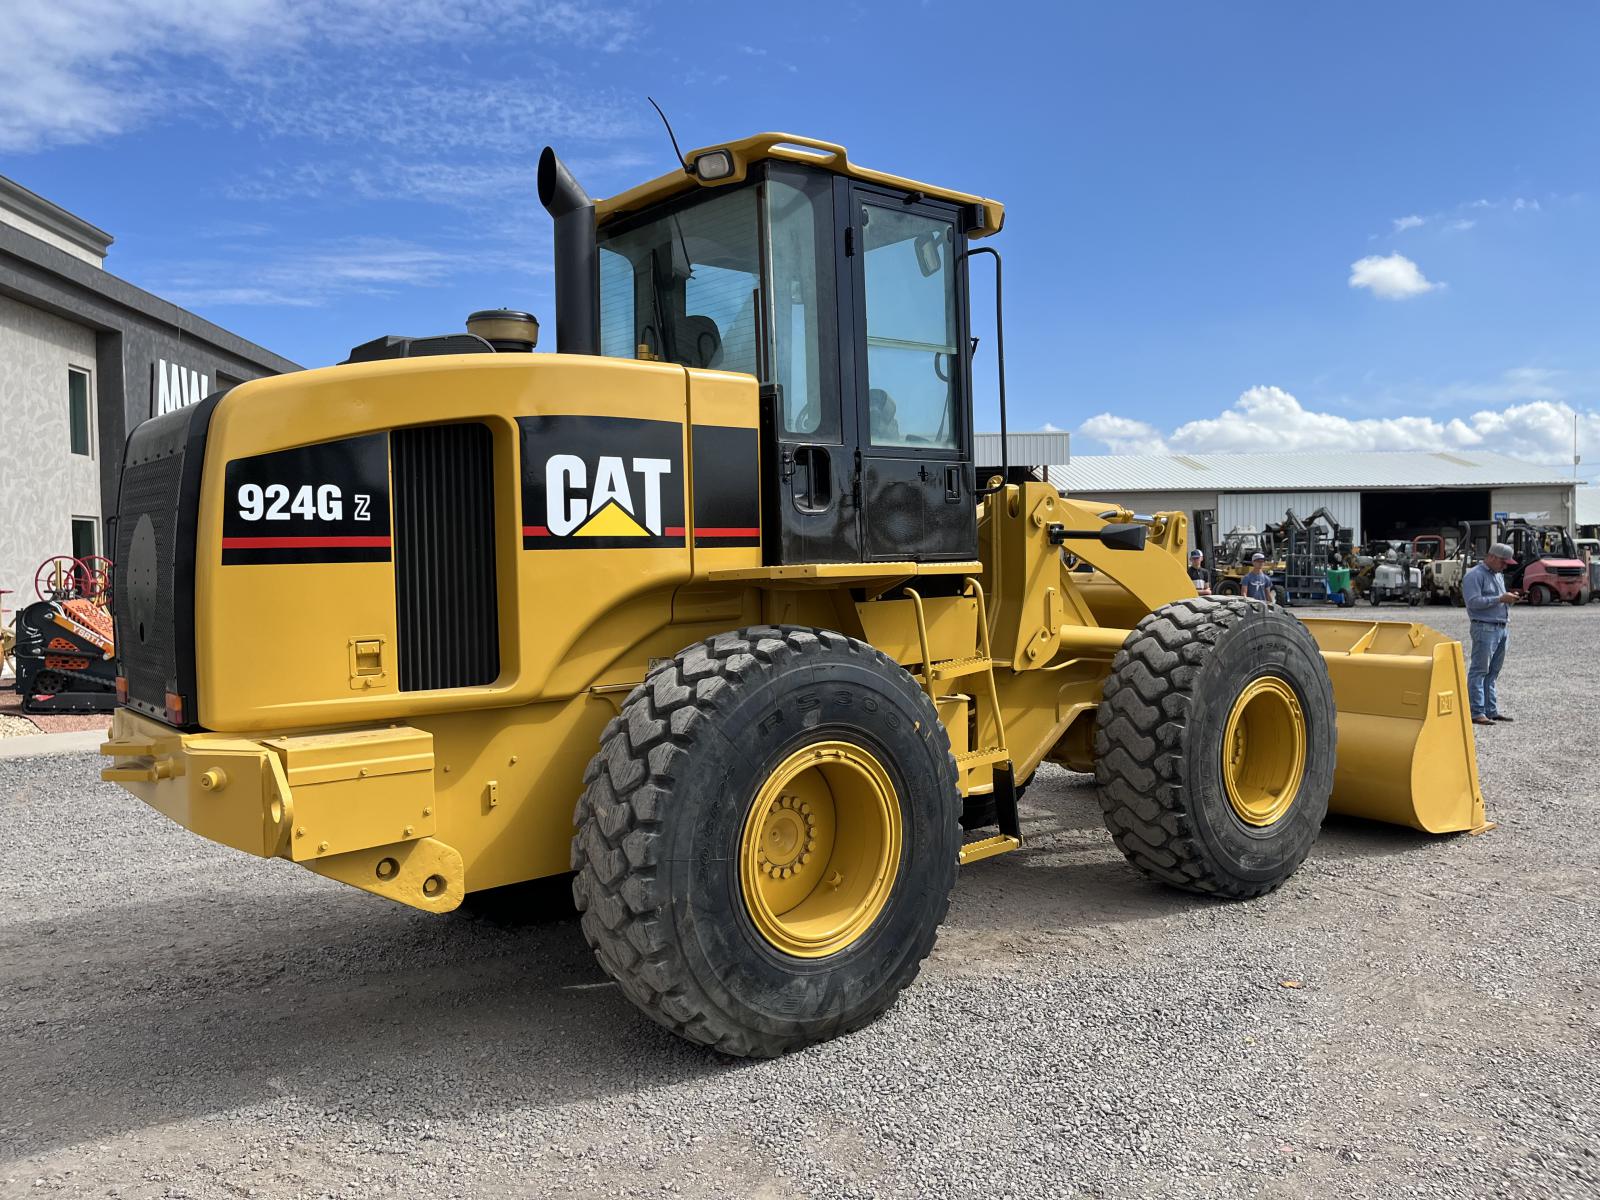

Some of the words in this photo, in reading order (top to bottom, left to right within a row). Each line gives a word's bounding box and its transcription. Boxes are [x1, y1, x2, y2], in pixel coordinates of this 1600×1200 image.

[238, 484, 342, 521] 924G
[354, 495, 370, 521] Z
[546, 455, 671, 536] CAT
